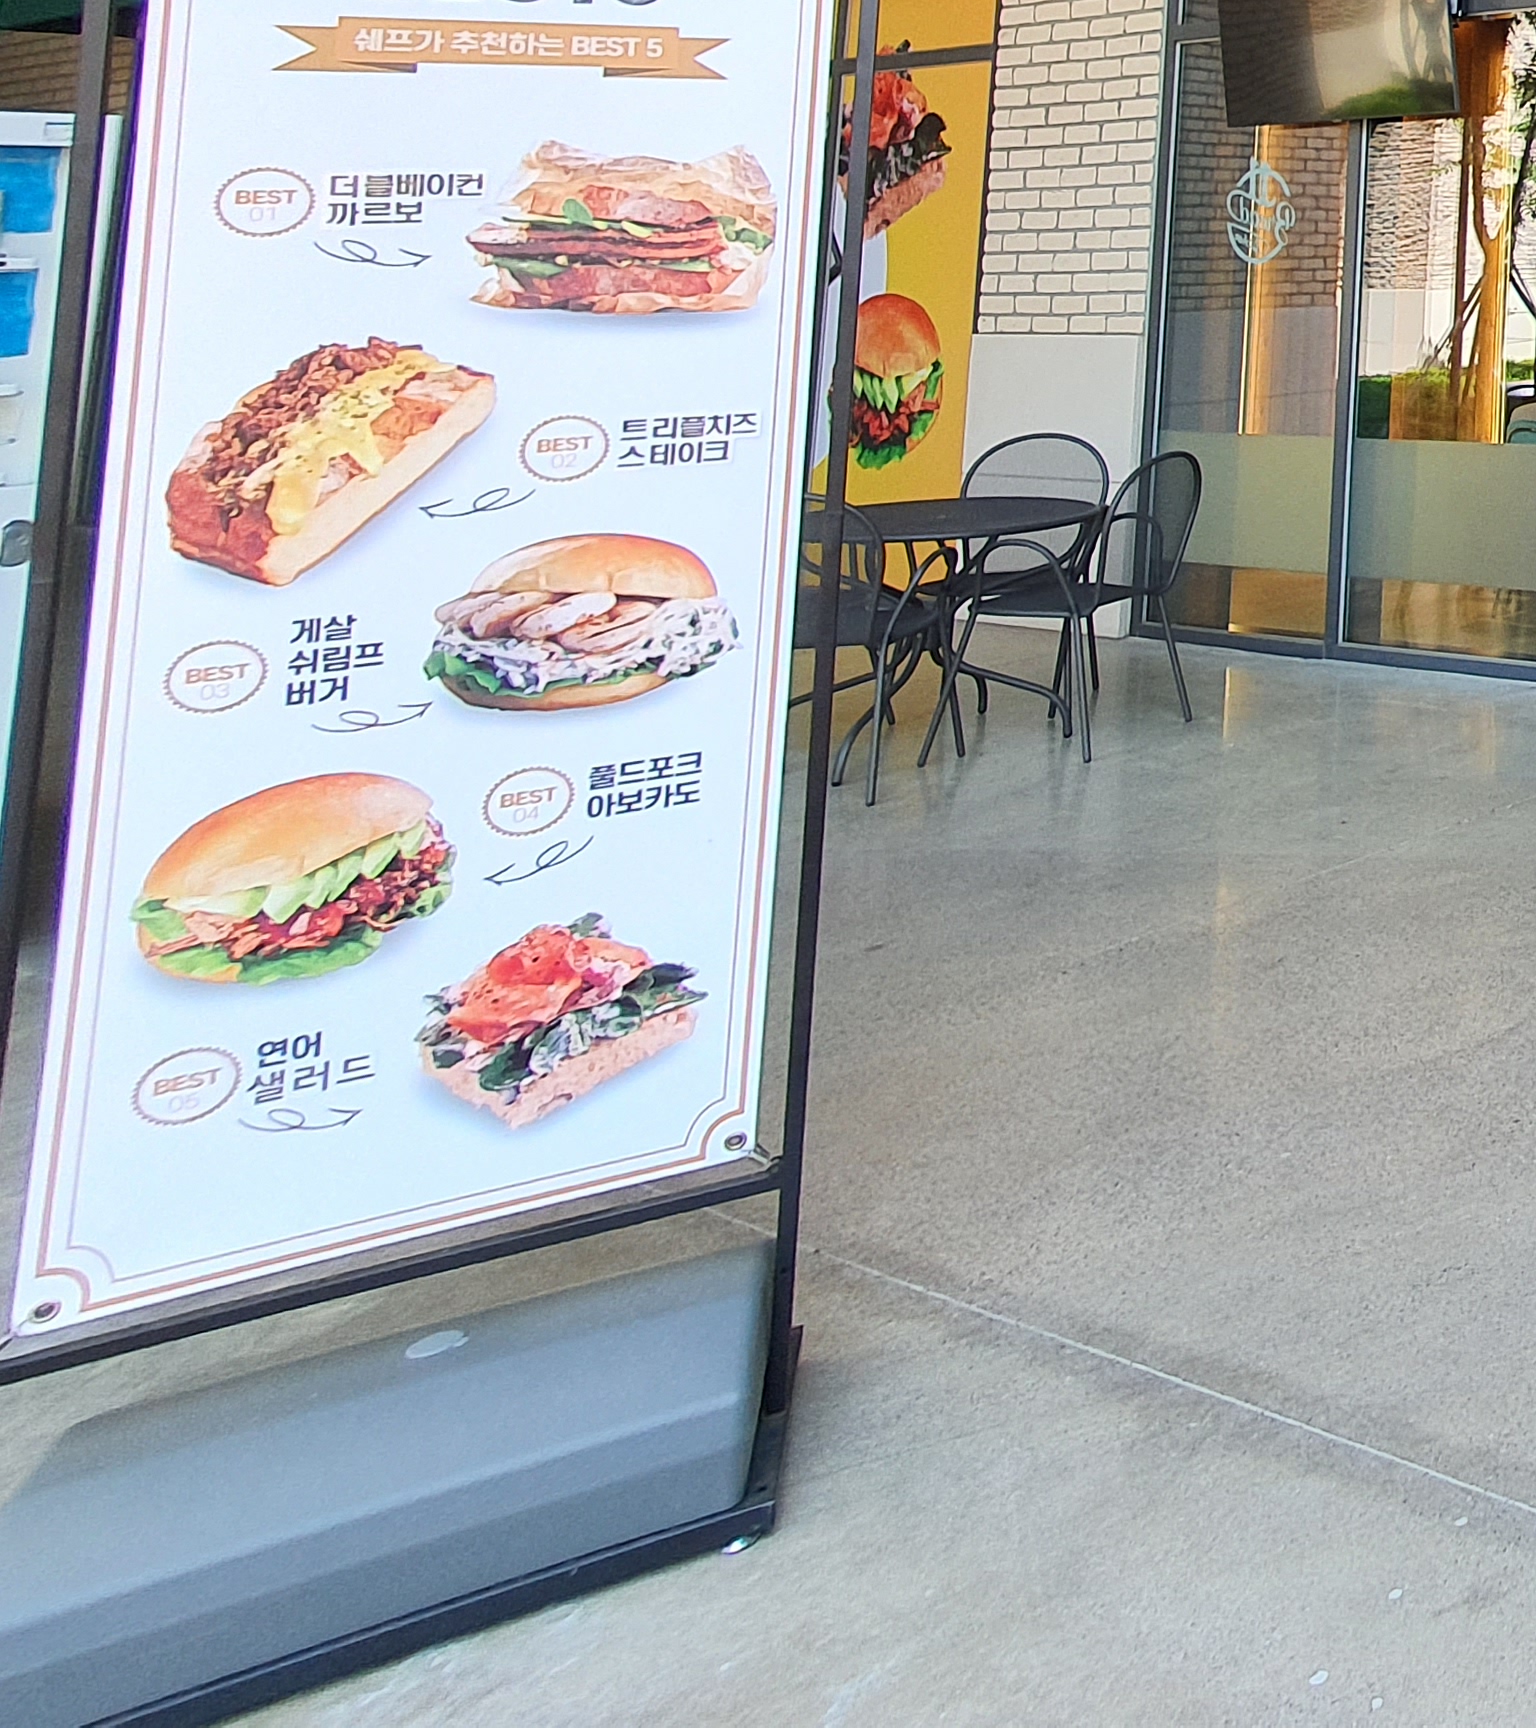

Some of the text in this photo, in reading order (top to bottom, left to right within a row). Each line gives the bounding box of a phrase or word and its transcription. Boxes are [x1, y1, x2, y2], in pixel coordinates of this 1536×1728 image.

[353, 27, 665, 59] 쉐프가 추천하는 BEST 5
[234, 189, 298, 206] BEST
[328, 173, 485, 198] 더블베이컨
[248, 206, 278, 223] 01
[325, 201, 424, 227] 까르보
[618, 413, 758, 442] 트리플치즈
[535, 435, 594, 455] BEST
[616, 440, 731, 469] 스테이크
[550, 453, 578, 470] 02
[289, 614, 358, 645] 게살
[287, 641, 385, 677] 쉬림프
[184, 662, 252, 685] BEST
[199, 683, 231, 701] 03
[284, 675, 350, 707] 버거
[588, 750, 704, 791] 풀드포크
[499, 786, 559, 809] BEST
[586, 779, 702, 819] 아보카도
[511, 806, 540, 824] 04
[256, 1030, 323, 1069] 연어
[152, 1067, 223, 1097] BEST
[167, 1093, 201, 1114] 05
